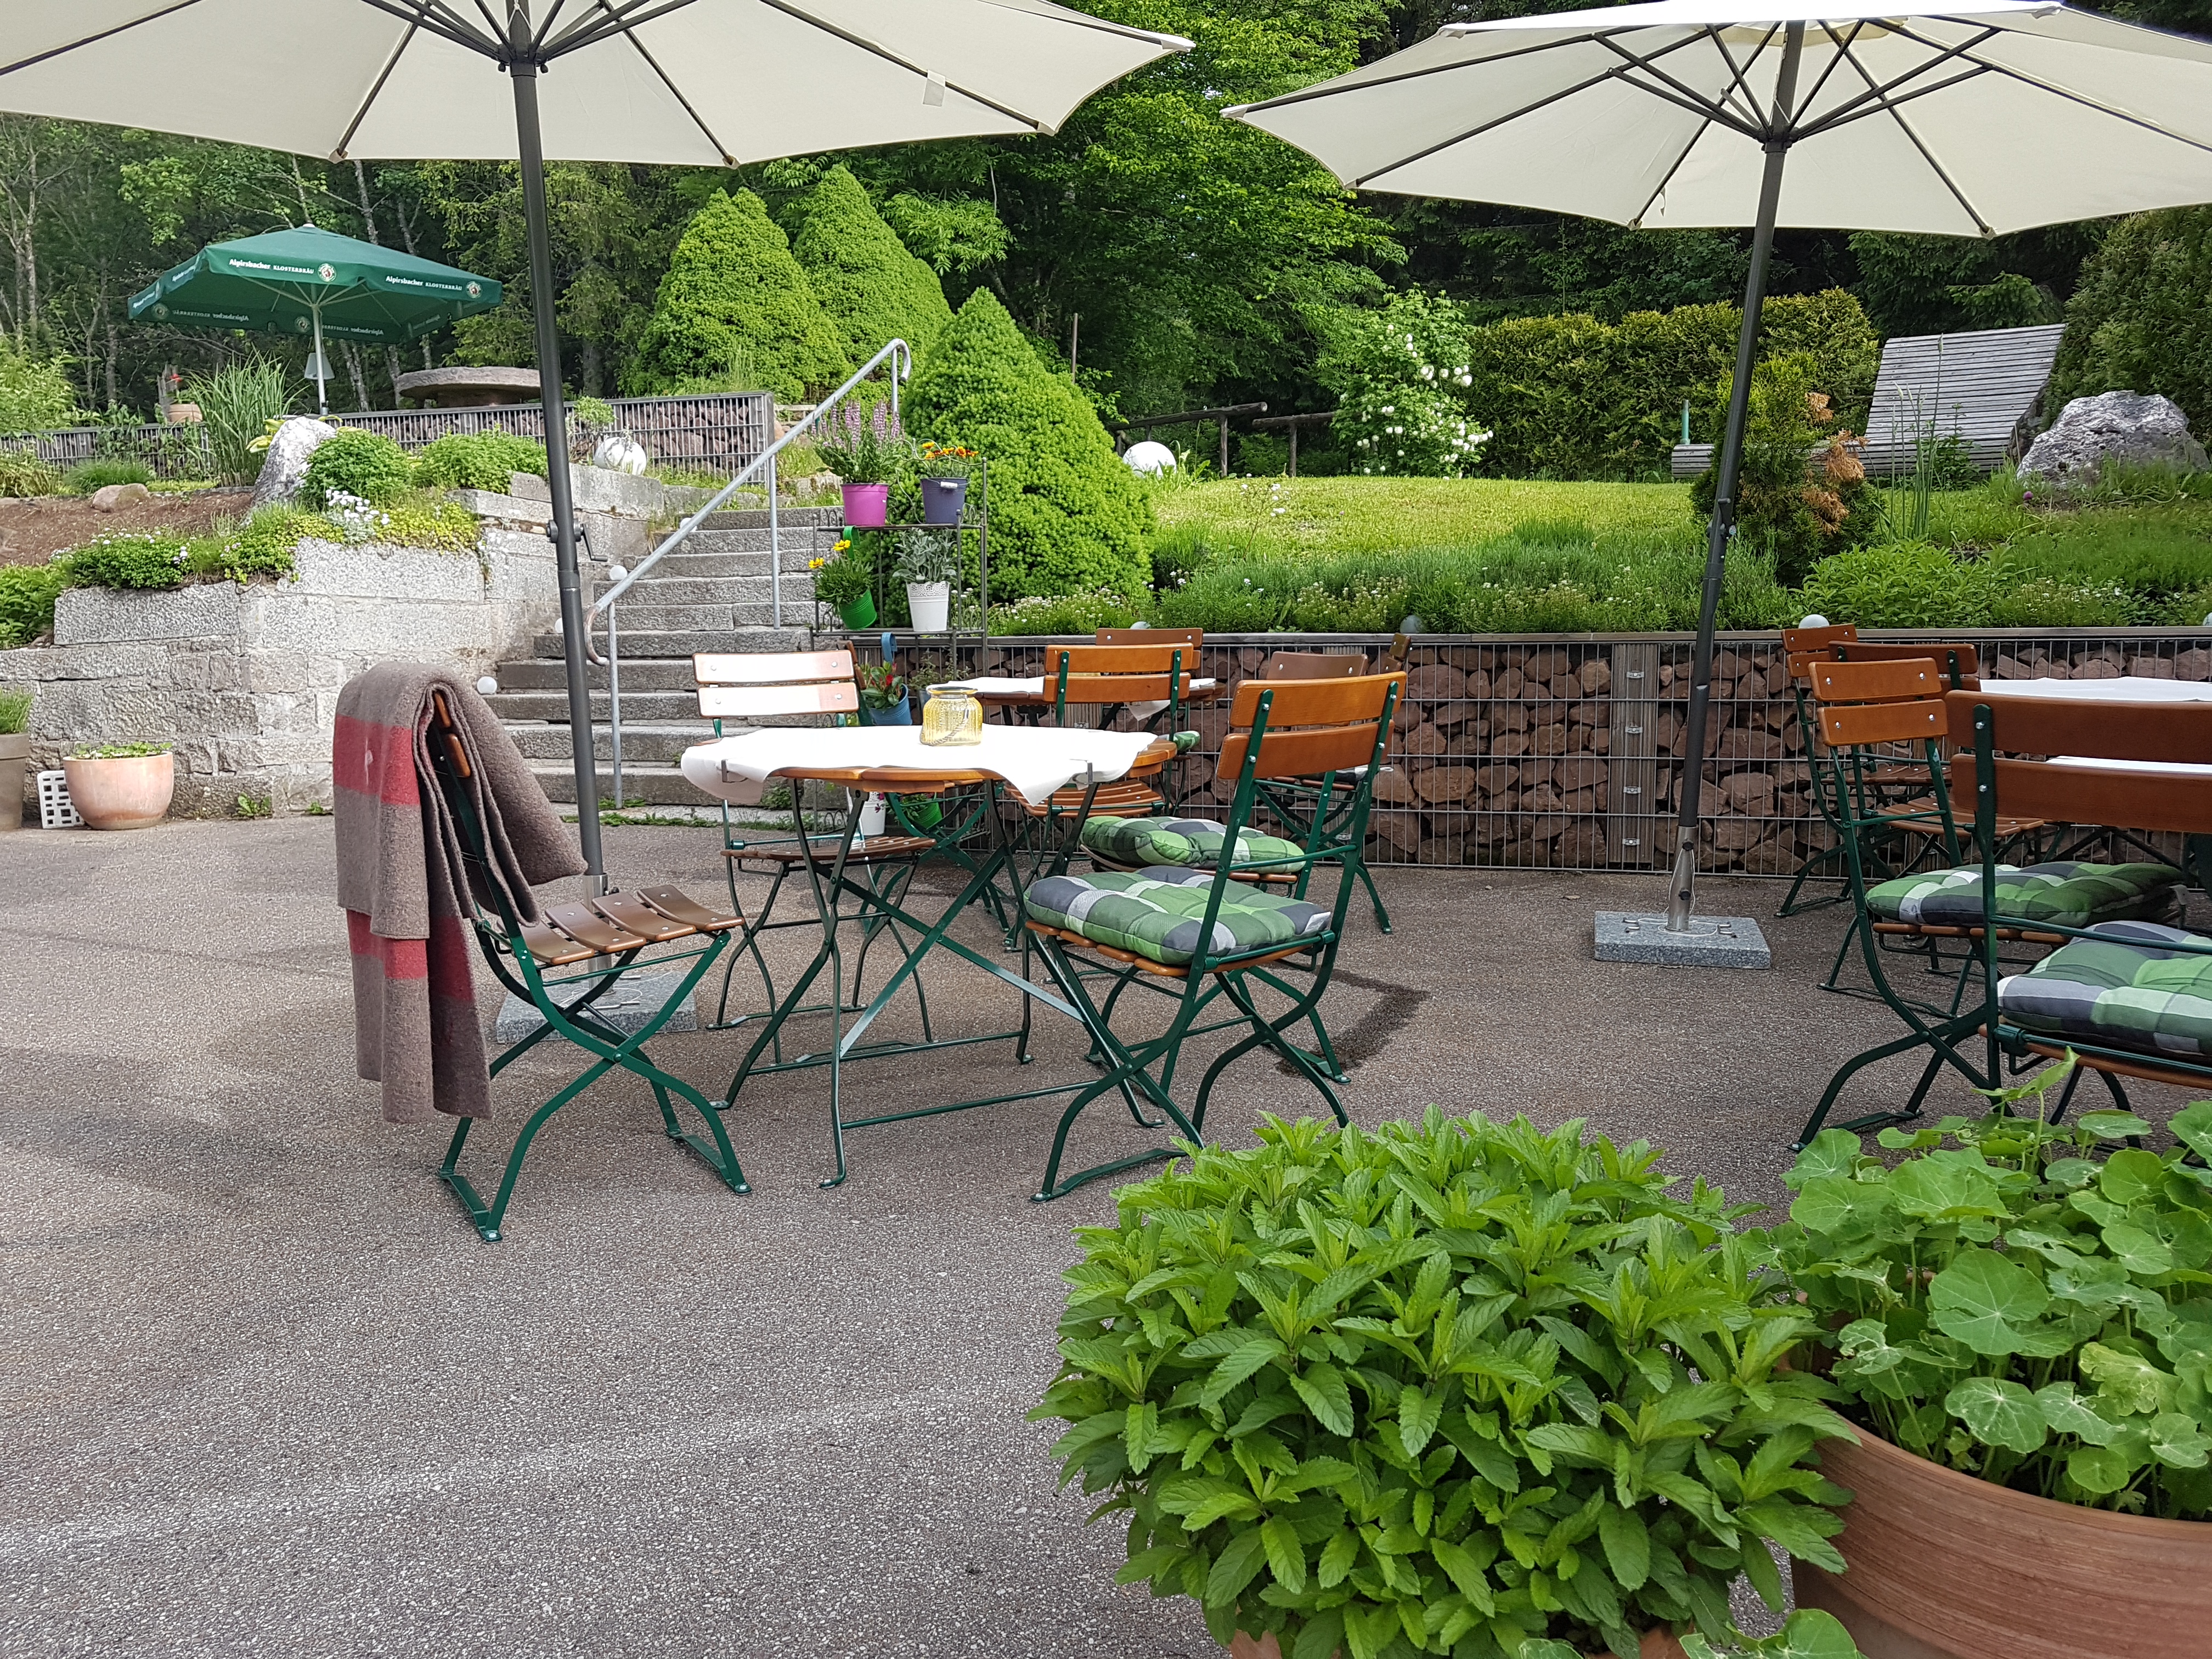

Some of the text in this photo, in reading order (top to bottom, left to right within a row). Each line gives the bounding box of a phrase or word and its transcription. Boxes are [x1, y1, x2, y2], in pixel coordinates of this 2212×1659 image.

[229, 258, 271, 269] Alpirsbacher
[273, 265, 314, 274] KLOSTERBRÄU
[386, 275, 424, 286] Alpirsbacher
[425, 282, 462, 291] KLOSTERBRÄU
